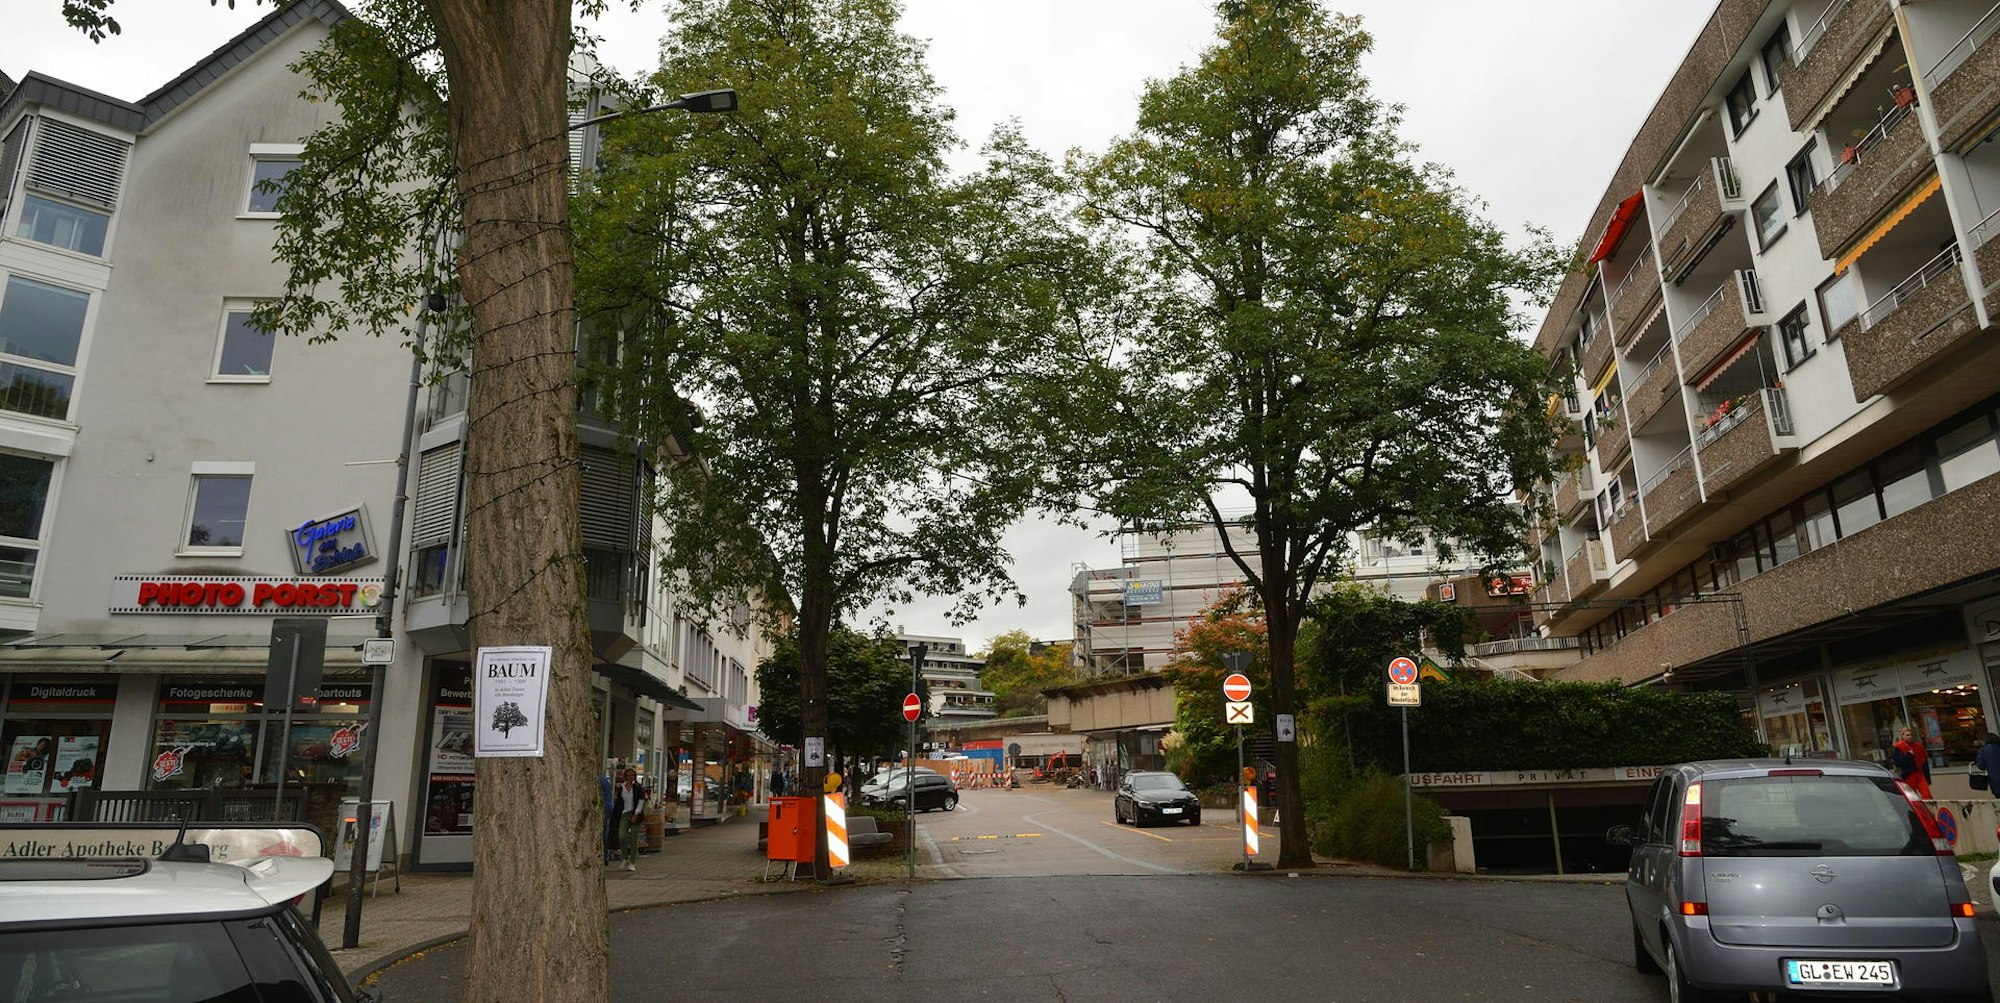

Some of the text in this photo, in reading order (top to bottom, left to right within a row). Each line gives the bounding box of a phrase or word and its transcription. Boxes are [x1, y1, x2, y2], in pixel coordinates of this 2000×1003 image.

[296, 517, 355, 563] Galerie
[137, 581, 358, 608] PHOTO PORST
[487, 663, 537, 678] BAUM
[30, 686, 97, 699] Digitaldruck
[169, 687, 254, 700] Fotogeschenke
[1403, 773, 1484, 785] USFAHRT
[1518, 771, 1586, 781] PRIVAT
[3, 840, 56, 857] Adler
[60, 839, 145, 858] Apotheke
[1798, 964, 1889, 980] GL EW 245
